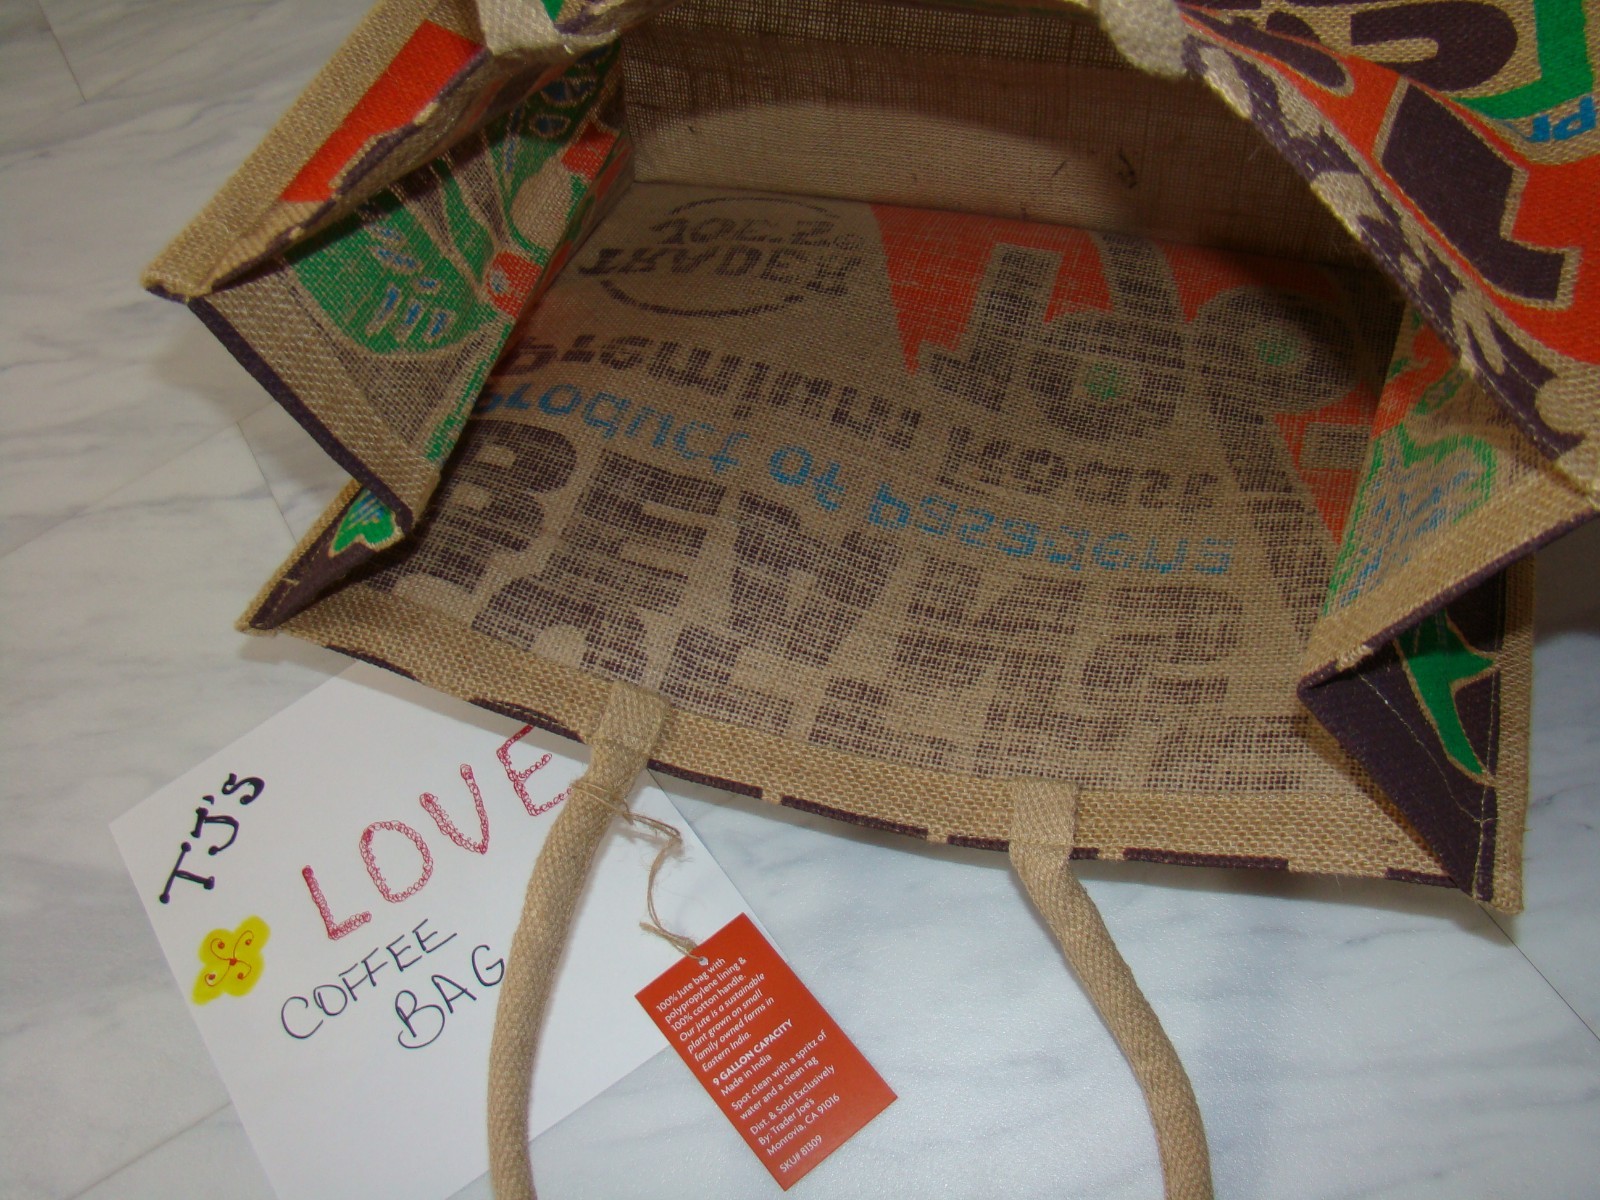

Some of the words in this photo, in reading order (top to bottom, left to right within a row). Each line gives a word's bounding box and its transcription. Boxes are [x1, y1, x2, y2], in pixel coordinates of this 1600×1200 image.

[302, 725, 573, 940] LOVE
[281, 919, 457, 1039] COFFEE
[394, 944, 505, 1049] BAG
[656, 993, 678, 1012] 100%
[692, 972, 709, 985] bag
[707, 959, 726, 973] with
[665, 980, 718, 1024] polypropylene
[717, 963, 741, 981] lining
[680, 1028, 695, 1041] Our
[696, 1016, 711, 1032] jute
[725, 973, 765, 1007] sustainable
[671, 1013, 693, 1031] 100%
[693, 995, 719, 1016] cotton
[688, 1033, 707, 1054] plant
[708, 1016, 732, 1038] grown
[743, 989, 763, 1009] small
[695, 1040, 718, 1062] family
[720, 1018, 745, 1043] owned
[744, 1004, 766, 1023] farms
[702, 1048, 731, 1072] Eastern
[720, 1050, 755, 1080] GALLON
[754, 1019, 792, 1053] CAPACITY
[721, 1077, 744, 1096] Made
[751, 1055, 772, 1072] India
[732, 1093, 751, 1110] Spot
[752, 1077, 772, 1095] clean
[772, 1062, 790, 1077] with
[796, 1040, 818, 1059] spritz
[740, 1101, 762, 1120] water
[763, 1086, 778, 1103] and
[784, 1067, 805, 1085] clean
[804, 1057, 819, 1069] rag
[776, 1096, 795, 1114] Sold
[793, 1065, 835, 1100] Exclusively
[817, 1093, 840, 1114] 91016
[770, 1113, 796, 1134] Trader
[800, 1135, 822, 1156] 81309
